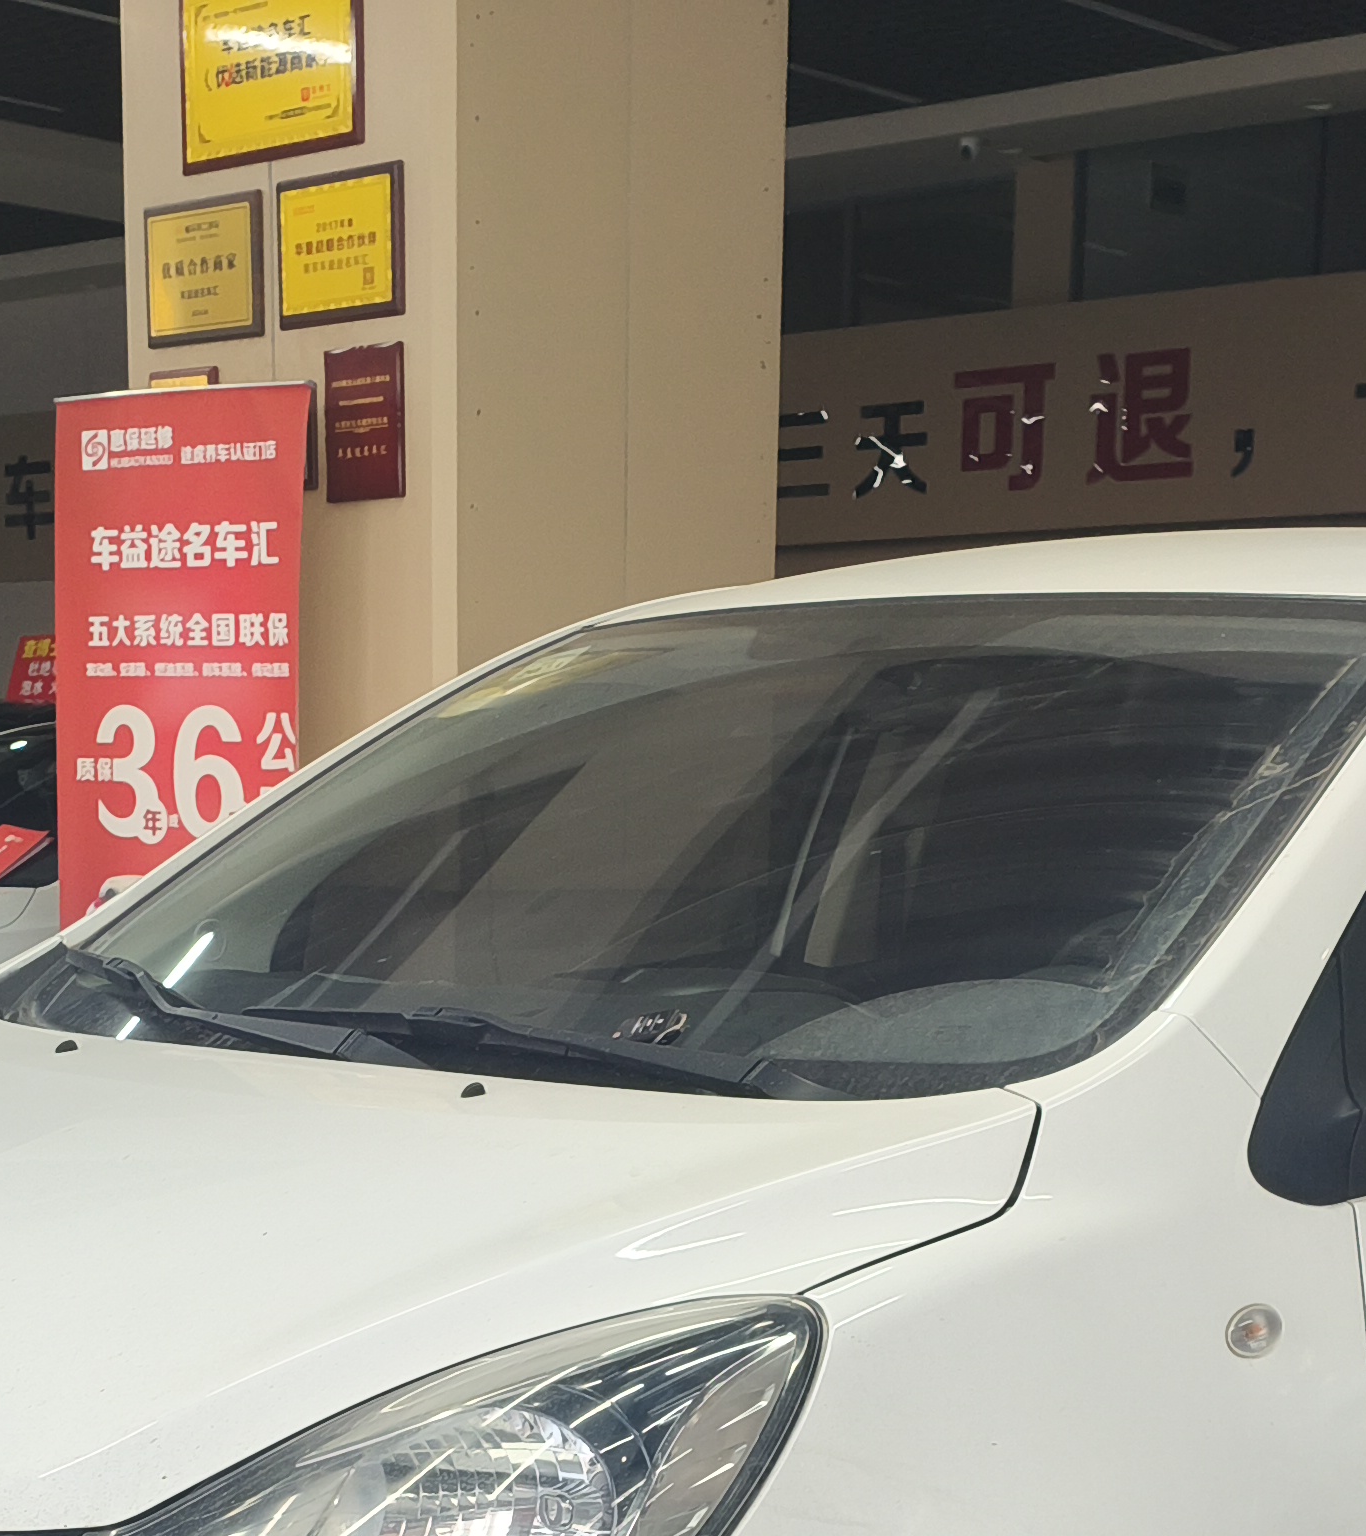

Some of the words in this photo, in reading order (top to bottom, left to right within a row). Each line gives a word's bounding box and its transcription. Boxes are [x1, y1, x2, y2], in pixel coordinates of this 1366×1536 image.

[90, 520, 280, 571] 车益途名车汇
[87, 612, 289, 648] 五大系统全国联保
[76, 757, 112, 782] 质保
